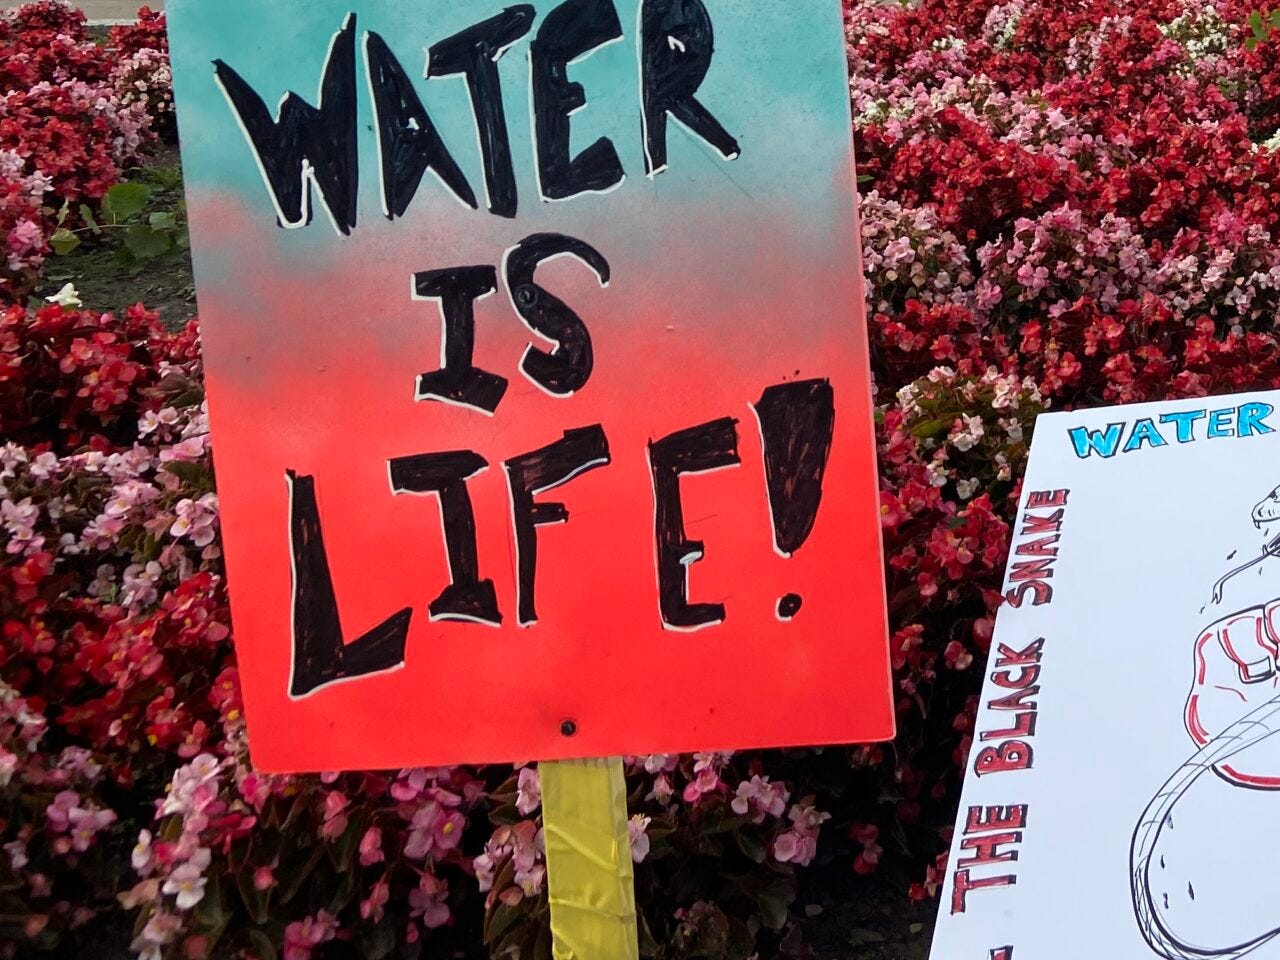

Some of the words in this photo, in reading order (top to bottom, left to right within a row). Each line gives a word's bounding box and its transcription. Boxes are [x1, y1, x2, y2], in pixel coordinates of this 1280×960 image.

[410, 231, 612, 417] IS
[1067, 401, 1275, 459] WATER
[285, 376, 836, 701] LIFE!
[1005, 488, 1071, 608] SNAKE
[974, 636, 1046, 779] BLACK
[950, 803, 1029, 916] THE
